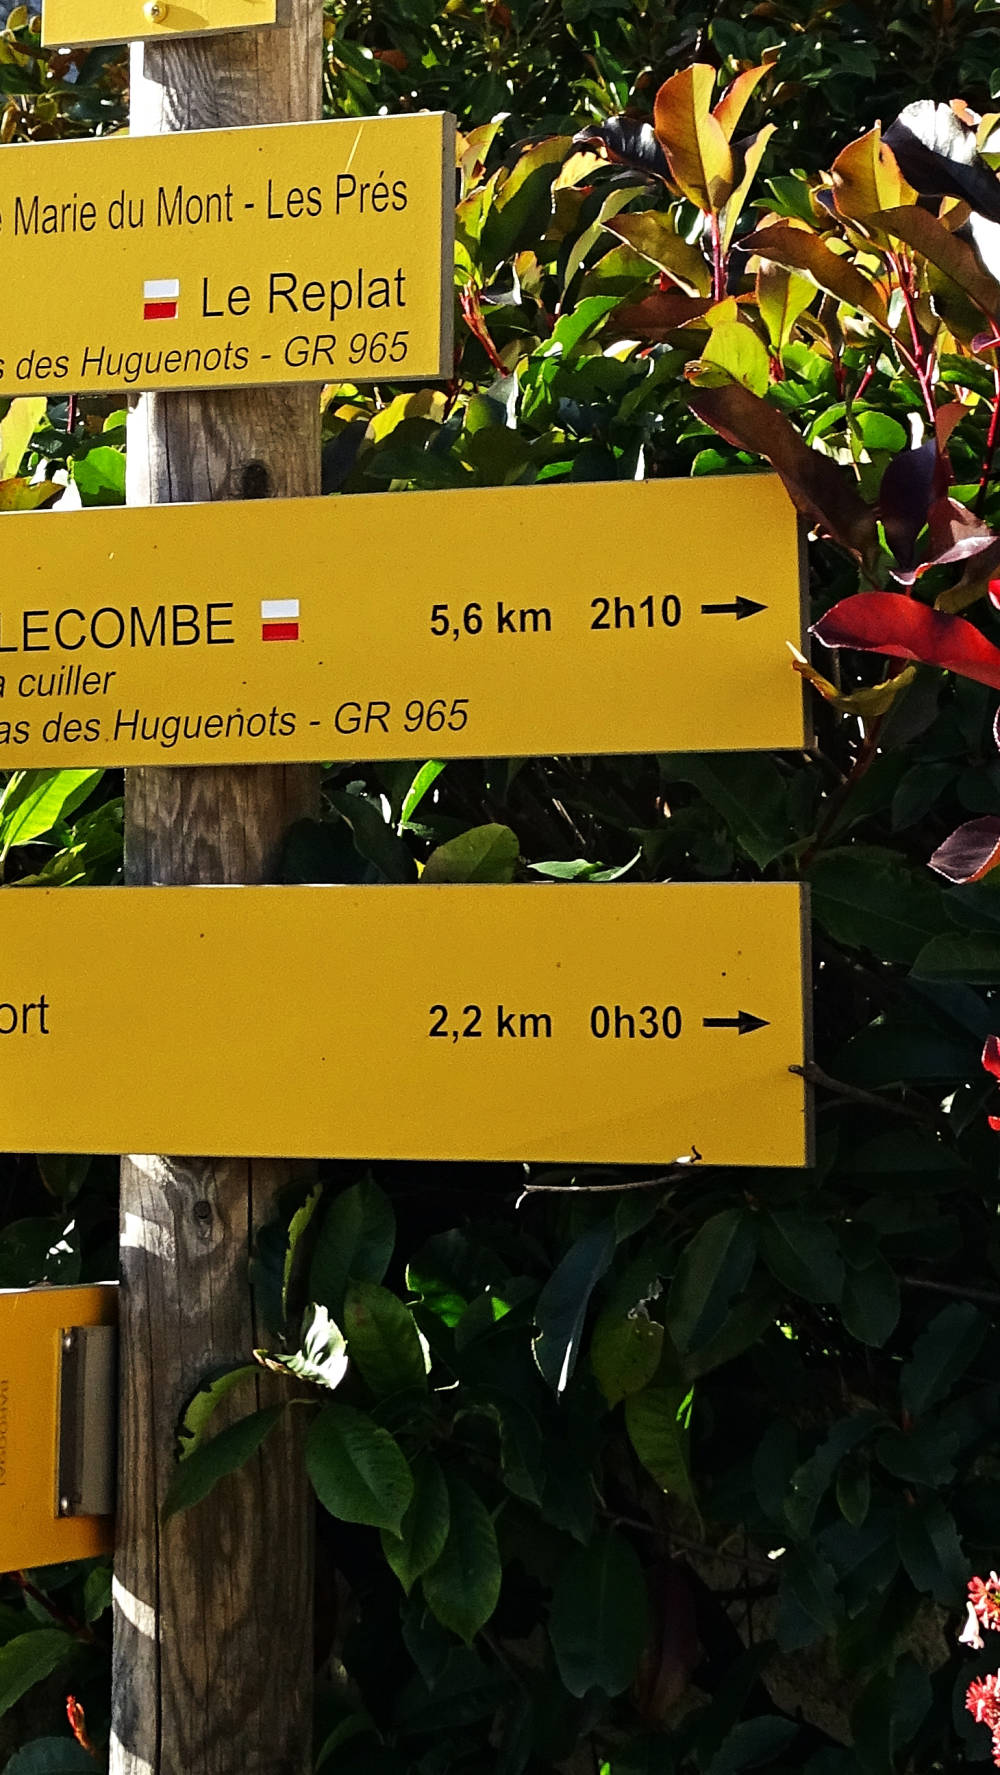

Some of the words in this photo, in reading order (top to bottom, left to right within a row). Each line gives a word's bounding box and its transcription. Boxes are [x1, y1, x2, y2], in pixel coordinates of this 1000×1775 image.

[14, 192, 97, 236] Marie
[108, 189, 144, 230] du
[157, 184, 234, 227] Mont
[267, 179, 322, 219] Les
[336, 170, 408, 215] Prés
[202, 277, 251, 318] Le
[269, 267, 406, 322] Replat
[16, 349, 70, 380] des
[80, 341, 250, 384] Huguenots
[284, 334, 337, 367] GR
[348, 330, 409, 365] 965
[430, 602, 483, 639] 5,6
[497, 601, 552, 634] km
[590, 594, 681, 630] 2h10
[18, 664, 117, 698] cuiller
[42, 711, 101, 743] des
[113, 706, 296, 748] Huguenots
[334, 701, 391, 735] GR
[403, 698, 469, 733] 965
[429, 1004, 482, 1044] 2,2
[497, 1004, 552, 1038] km
[590, 1005, 682, 1039] 0h30
